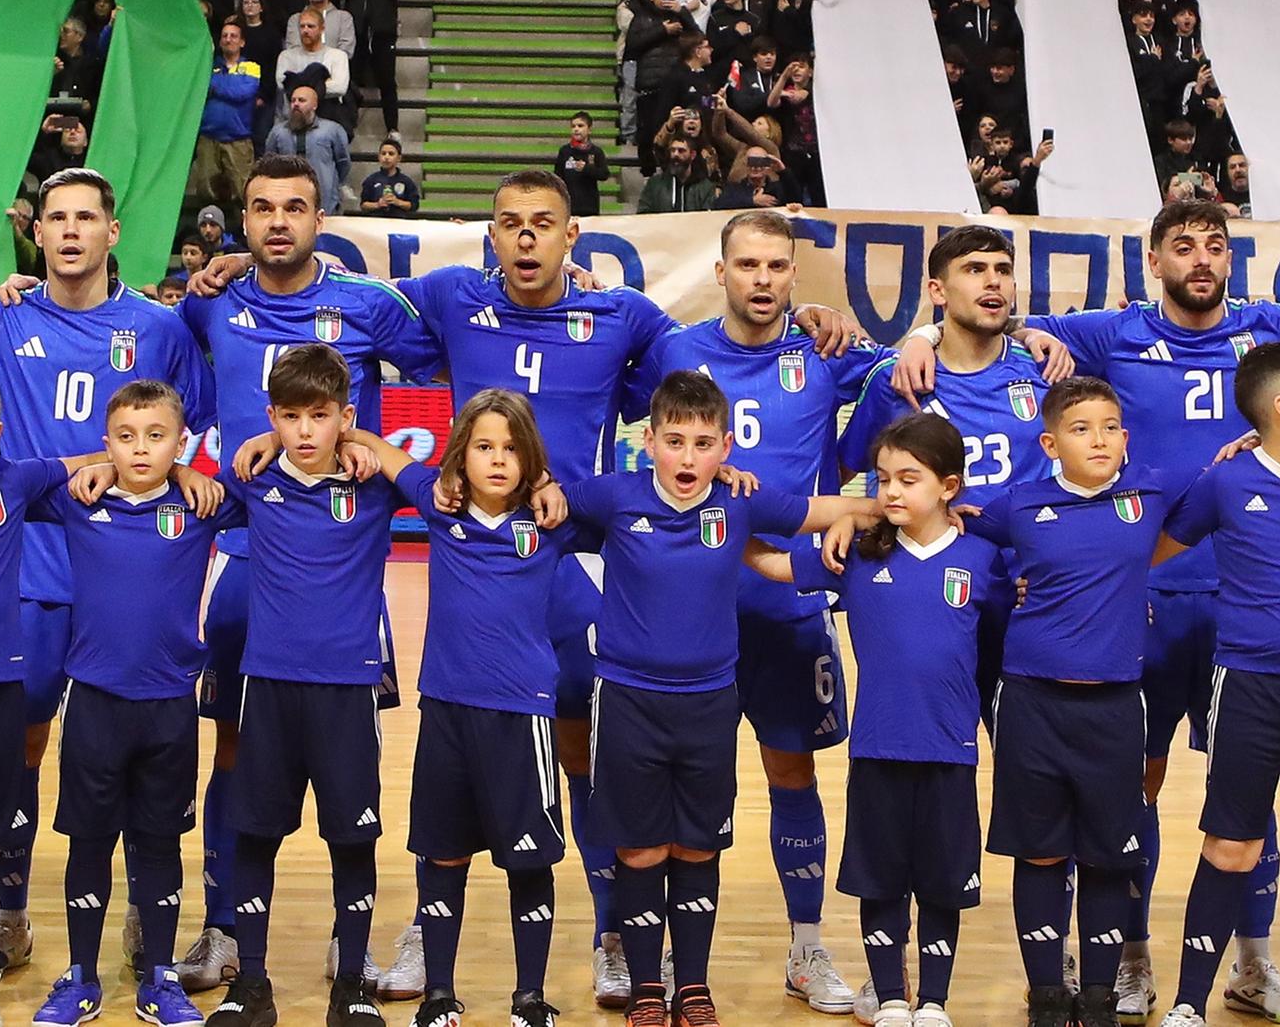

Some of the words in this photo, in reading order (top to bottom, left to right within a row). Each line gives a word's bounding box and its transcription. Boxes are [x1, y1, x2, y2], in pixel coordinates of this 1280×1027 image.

[112, 337, 133, 347] ITALIA
[515, 343, 542, 393] 4
[781, 358, 802, 367] ITALIA
[54, 369, 94, 422] 10
[1012, 387, 1032, 396] ITALIA
[1184, 369, 1223, 420] 21
[733, 400, 760, 449] 6
[963, 433, 1012, 488] 23
[703, 510, 723, 520] ITALIA
[514, 523, 534, 532] ITALIA
[947, 571, 969, 581] ITALIA
[814, 655, 835, 704] 6
[780, 834, 824, 848] ITALIA
[349, 1003, 380, 1017] PUMA
